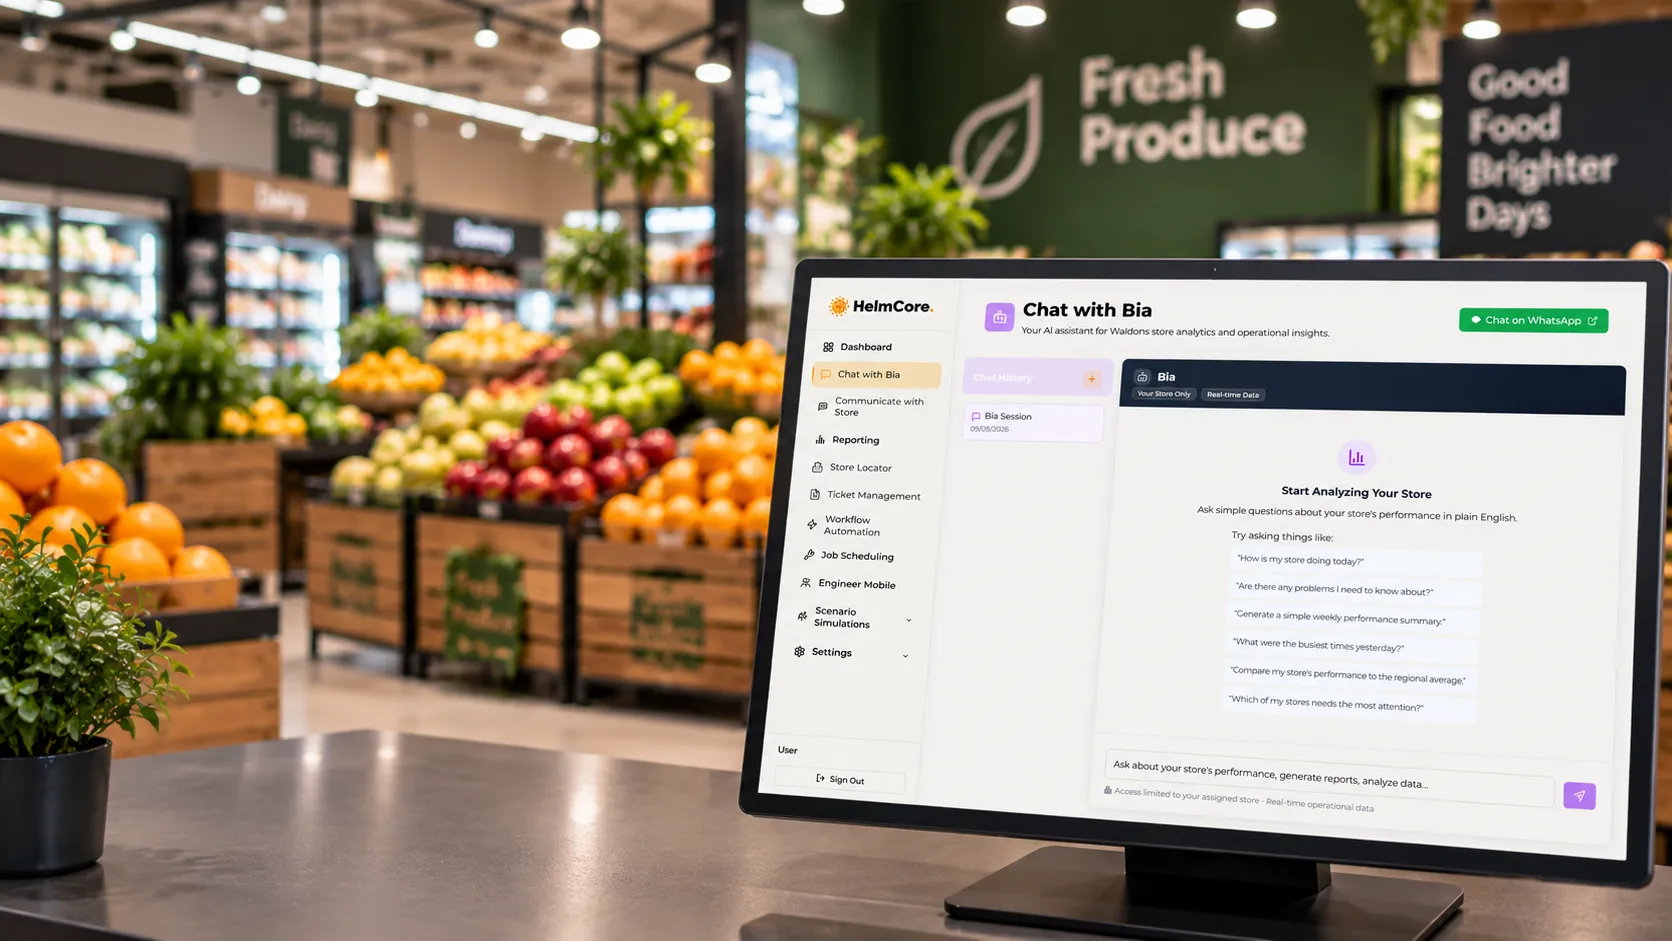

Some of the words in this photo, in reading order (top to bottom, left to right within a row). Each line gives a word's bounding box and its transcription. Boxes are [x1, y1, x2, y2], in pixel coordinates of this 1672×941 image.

[1080, 45, 1225, 108] Fresh
[1468, 56, 1571, 102] Good
[1468, 101, 1562, 146] Food
[1080, 104, 1307, 167] Produce
[1467, 147, 1619, 197] Brighter
[1466, 194, 1552, 239] Days
[1023, 301, 1069, 318] Chat
[1072, 301, 1117, 318] with
[1121, 301, 1153, 318] Bia
[1485, 315, 1510, 325] Chat
[1511, 317, 1526, 325] on
[1527, 315, 1582, 327] WhatsApp
[1021, 326, 1042, 335] Your
[1042, 326, 1053, 335] AI
[1054, 326, 1094, 336] assistant
[1095, 326, 1109, 336] for
[1109, 327, 1151, 336] Waldons
[1151, 328, 1175, 337] store
[1175, 327, 1216, 338] analytics
[1217, 328, 1236, 337] and
[1236, 328, 1290, 339] operational
[1291, 328, 1330, 340] insights.
[840, 342, 893, 352] Dashboard
[837, 369, 861, 379] Chat
[862, 370, 883, 379] with
[885, 370, 901, 379] Bia
[972, 373, 997, 383] Chat
[998, 373, 1033, 384] History
[1157, 371, 1176, 382] Bia
[835, 396, 902, 407] Communicate
[903, 397, 925, 406] with
[1136, 390, 1155, 398] Your
[1154, 390, 1174, 399] Store
[1174, 390, 1192, 400] Only
[1206, 391, 1242, 399] Real-time
[1242, 391, 1260, 399] Data
[834, 407, 860, 417] Store
[984, 411, 999, 420] Bia
[1000, 412, 1033, 421] Session
[832, 435, 880, 447] Reporting
[829, 462, 855, 472] Store
[856, 463, 893, 473] Locator
[827, 489, 856, 499] Ticket
[857, 491, 921, 502] Management
[1281, 485, 1310, 496] Start
[1311, 486, 1370, 500] Analyzing
[1371, 488, 1399, 499] Your
[1401, 488, 1433, 500] Store
[825, 515, 871, 525] Workflow
[1196, 505, 1215, 514] Ask
[1215, 505, 1247, 516] simple
[1247, 506, 1294, 517] questions
[1294, 507, 1323, 517] about
[1323, 510, 1346, 519] your
[1347, 509, 1377, 519] store's
[1378, 510, 1441, 521] performance
[1443, 511, 1453, 521] in
[1454, 512, 1478, 523] plain
[1480, 512, 1518, 524] English.
[823, 526, 881, 537] Automation
[1231, 530, 1247, 542] Try
[1248, 531, 1280, 543] asking
[1281, 531, 1313, 544] things
[1314, 533, 1334, 543] like:
[820, 550, 839, 560] Job
[840, 551, 895, 564] Scheduling
[1260, 554, 1268, 563] is
[1268, 556, 1284, 565] my
[1283, 556, 1306, 565] store
[1306, 556, 1332, 567] doing
[818, 578, 862, 590] Engineer
[863, 580, 897, 590] Mobile
[1253, 582, 1277, 591] there
[1277, 584, 1294, 593] any
[1294, 584, 1336, 593] problems
[1340, 586, 1363, 594] need
[1363, 587, 1374, 595] to
[1374, 586, 1400, 596] know
[815, 606, 857, 617] Scenario
[1275, 612, 1282, 620] a
[1282, 611, 1312, 622] simple
[1312, 613, 1343, 624] weekly
[1343, 613, 1399, 625] performance
[813, 617, 871, 630] Simulations
[1259, 640, 1281, 648] were
[1281, 639, 1297, 648] the
[1297, 640, 1329, 650] busiest
[1329, 641, 1355, 651] times
[811, 647, 853, 659] Settings
[1271, 668, 1286, 678] my
[1286, 669, 1313, 678] store's
[1313, 669, 1368, 680] performance
[1368, 672, 1378, 681] to
[1378, 672, 1393, 682] the
[1393, 673, 1429, 684] regional
[1259, 695, 1270, 705] of
[1269, 698, 1285, 707] my
[1284, 698, 1311, 707] stores
[1311, 699, 1338, 708] needs
[1338, 700, 1354, 709] the
[1354, 702, 1377, 710] most
[777, 745, 799, 755] User
[829, 775, 849, 786] Sign
[849, 776, 865, 786] Out
[1112, 760, 1131, 769] Ask
[1131, 761, 1159, 772] about
[1159, 764, 1182, 774] your
[1183, 765, 1213, 775] store's
[1214, 766, 1278, 780] performance,
[1279, 772, 1323, 783] generate
[1323, 775, 1361, 786] reports,
[1361, 777, 1399, 789] analyze
[1113, 786, 1143, 797] Access
[1142, 789, 1172, 799] limited
[1171, 792, 1182, 800] to
[1181, 793, 1201, 802] your
[1201, 794, 1238, 805] assigned
[1239, 796, 1261, 805] store
[1265, 797, 1306, 809] Real-time
[1306, 801, 1354, 812] operational
[1354, 803, 1375, 814] data
